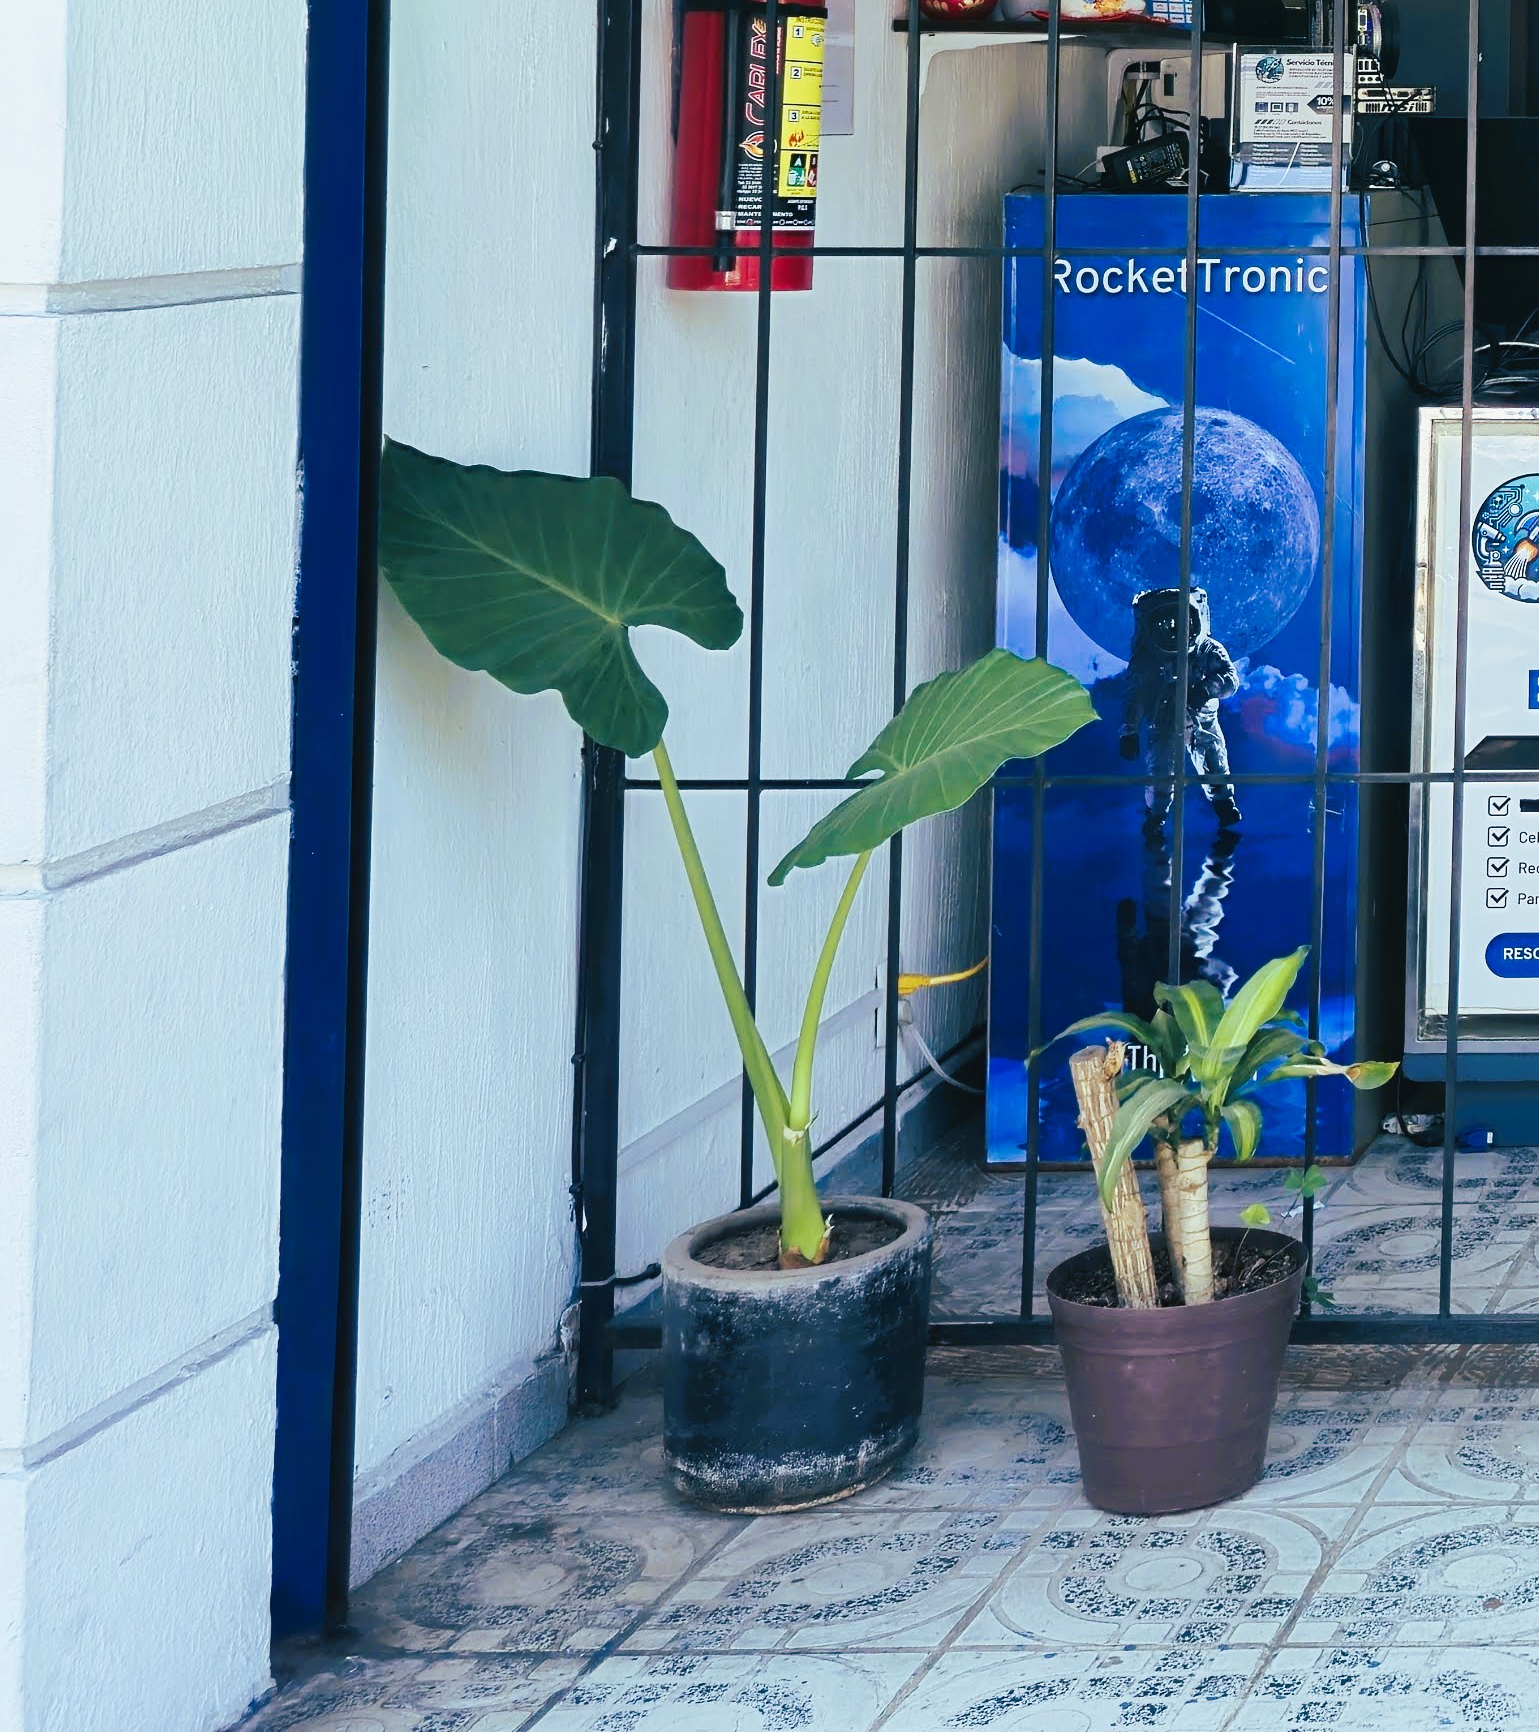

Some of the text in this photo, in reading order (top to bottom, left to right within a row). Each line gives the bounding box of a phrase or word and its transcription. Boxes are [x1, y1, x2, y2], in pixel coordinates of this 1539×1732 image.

[1286, 58, 1335, 66] Servicio Técni
[793, 69, 800, 77] 2
[791, 112, 798, 120] 3
[793, 155, 803, 167] A
[1054, 257, 1329, 294] RocketTronic
